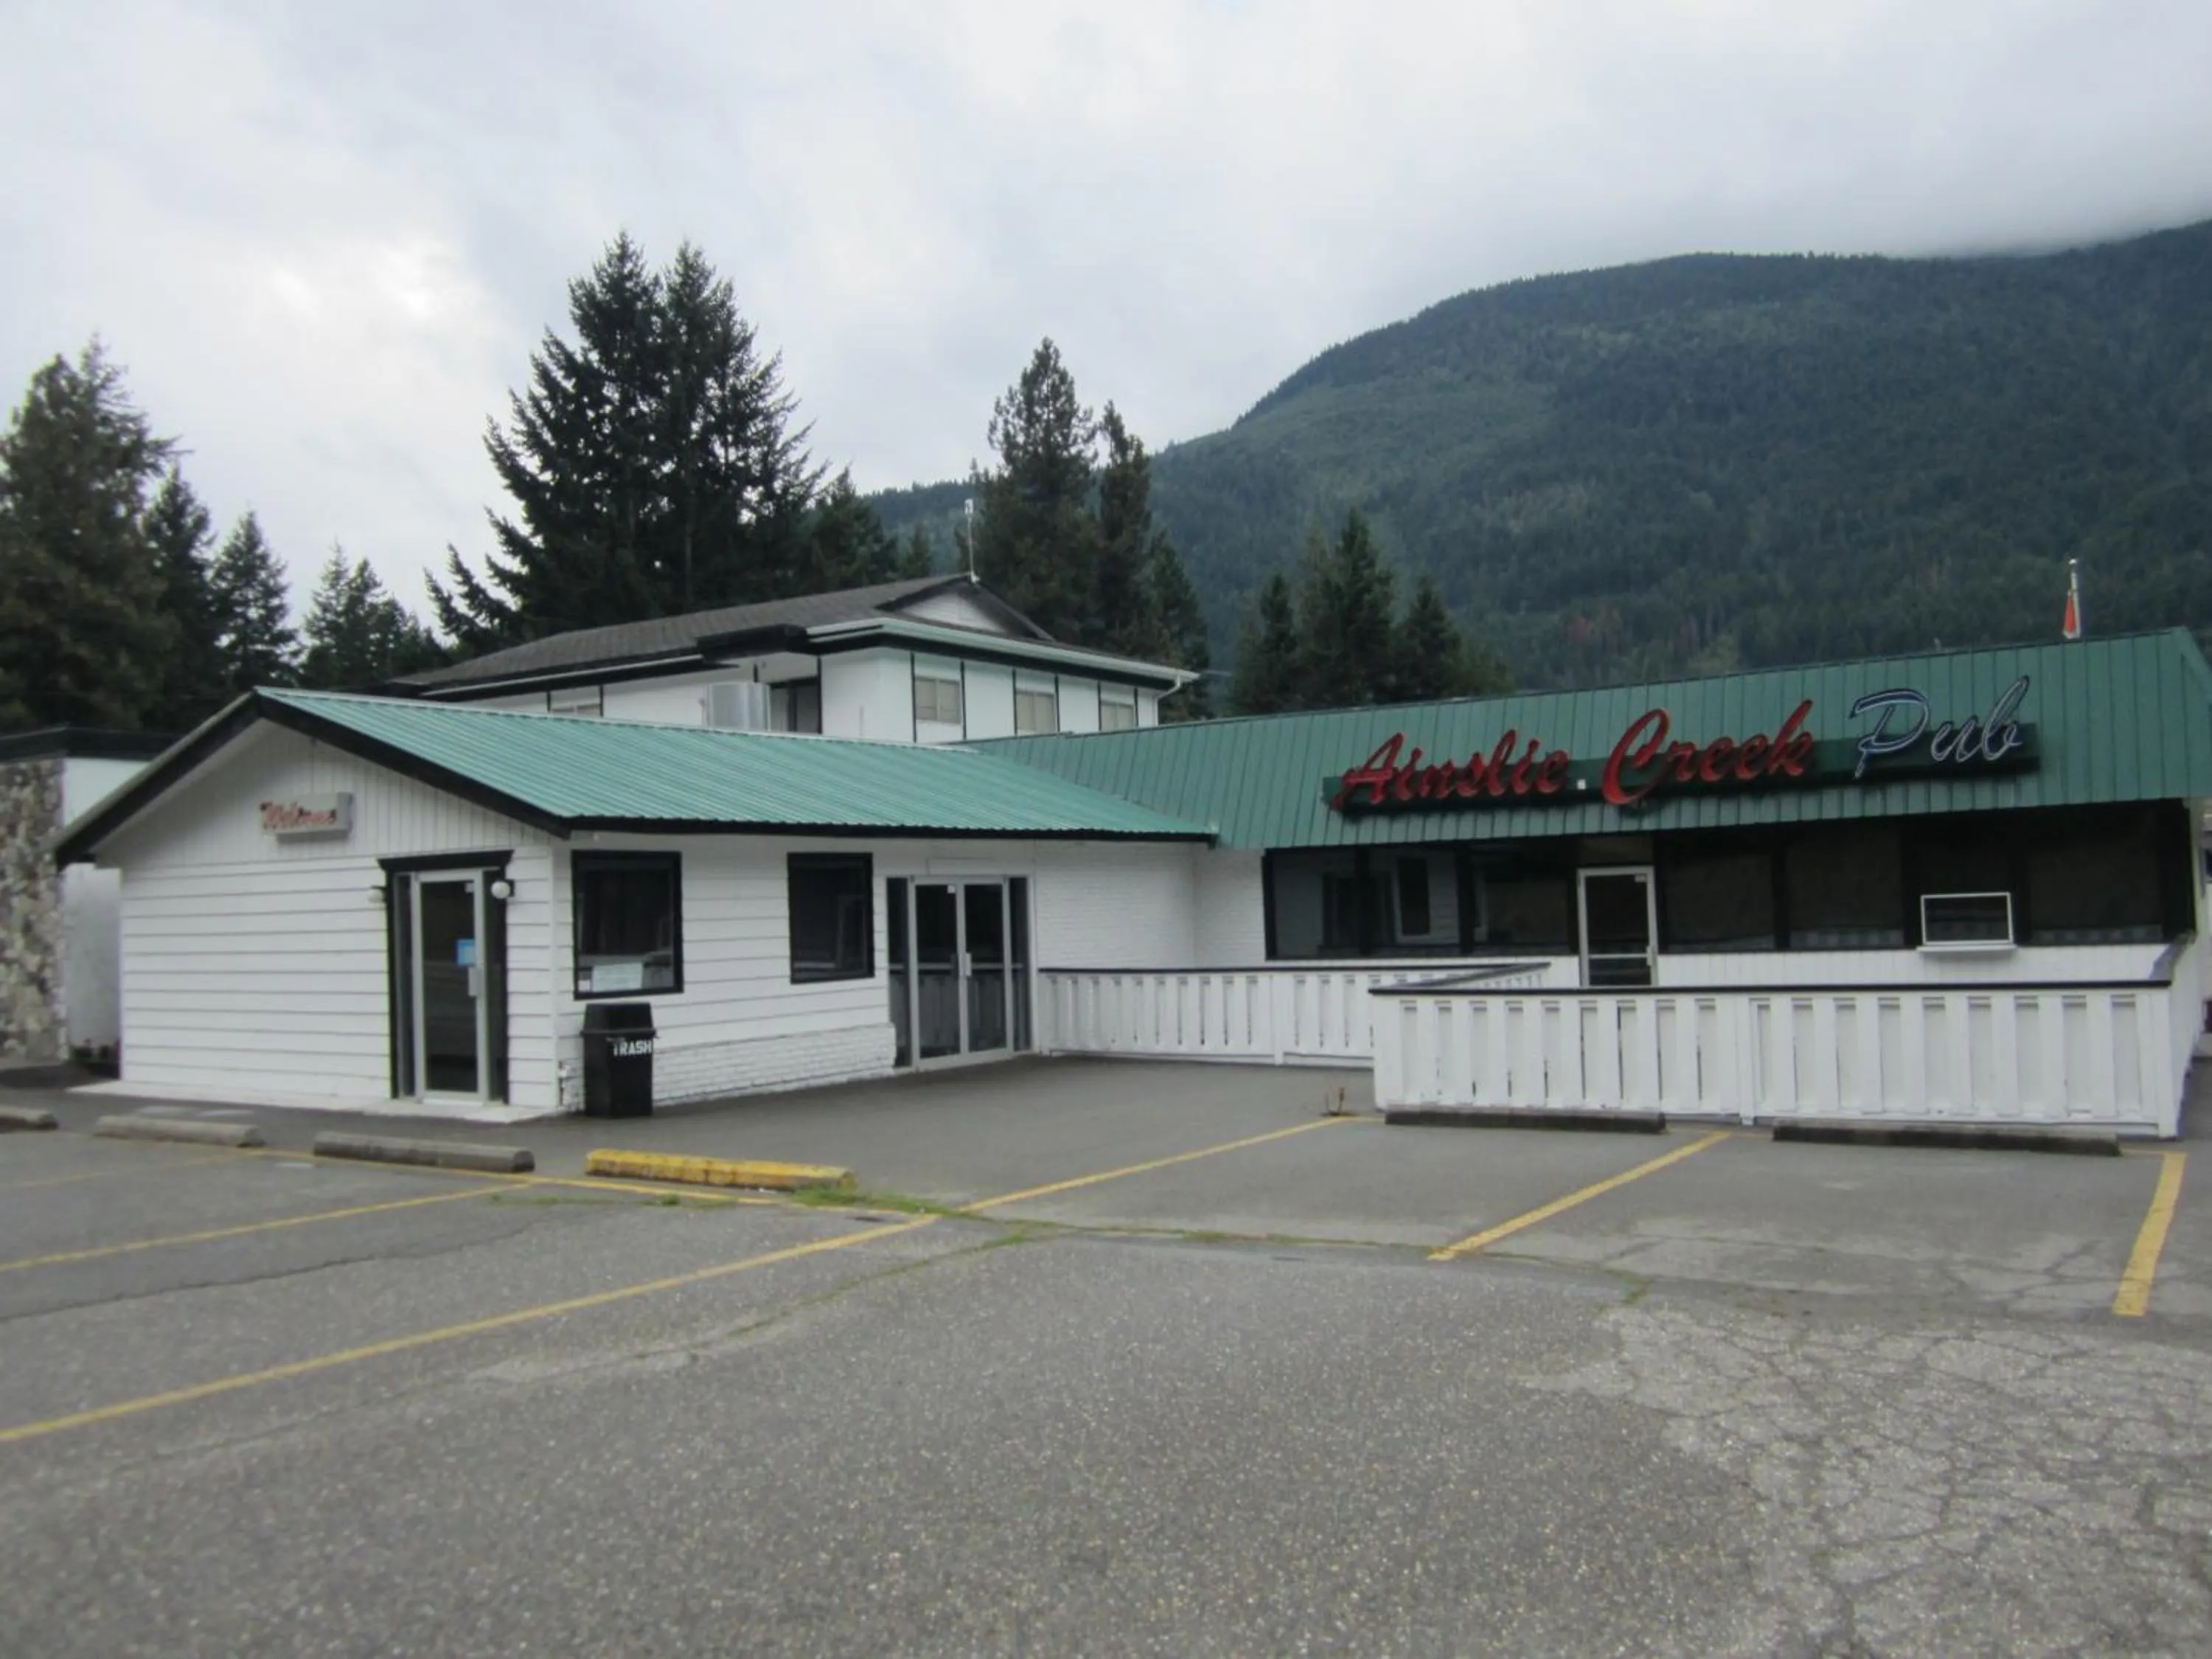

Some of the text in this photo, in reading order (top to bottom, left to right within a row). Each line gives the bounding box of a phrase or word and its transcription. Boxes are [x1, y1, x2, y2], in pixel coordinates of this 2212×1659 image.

[1332, 675, 2029, 809] Ainslie Creek Pub
[613, 1040, 652, 1057] TRASH
